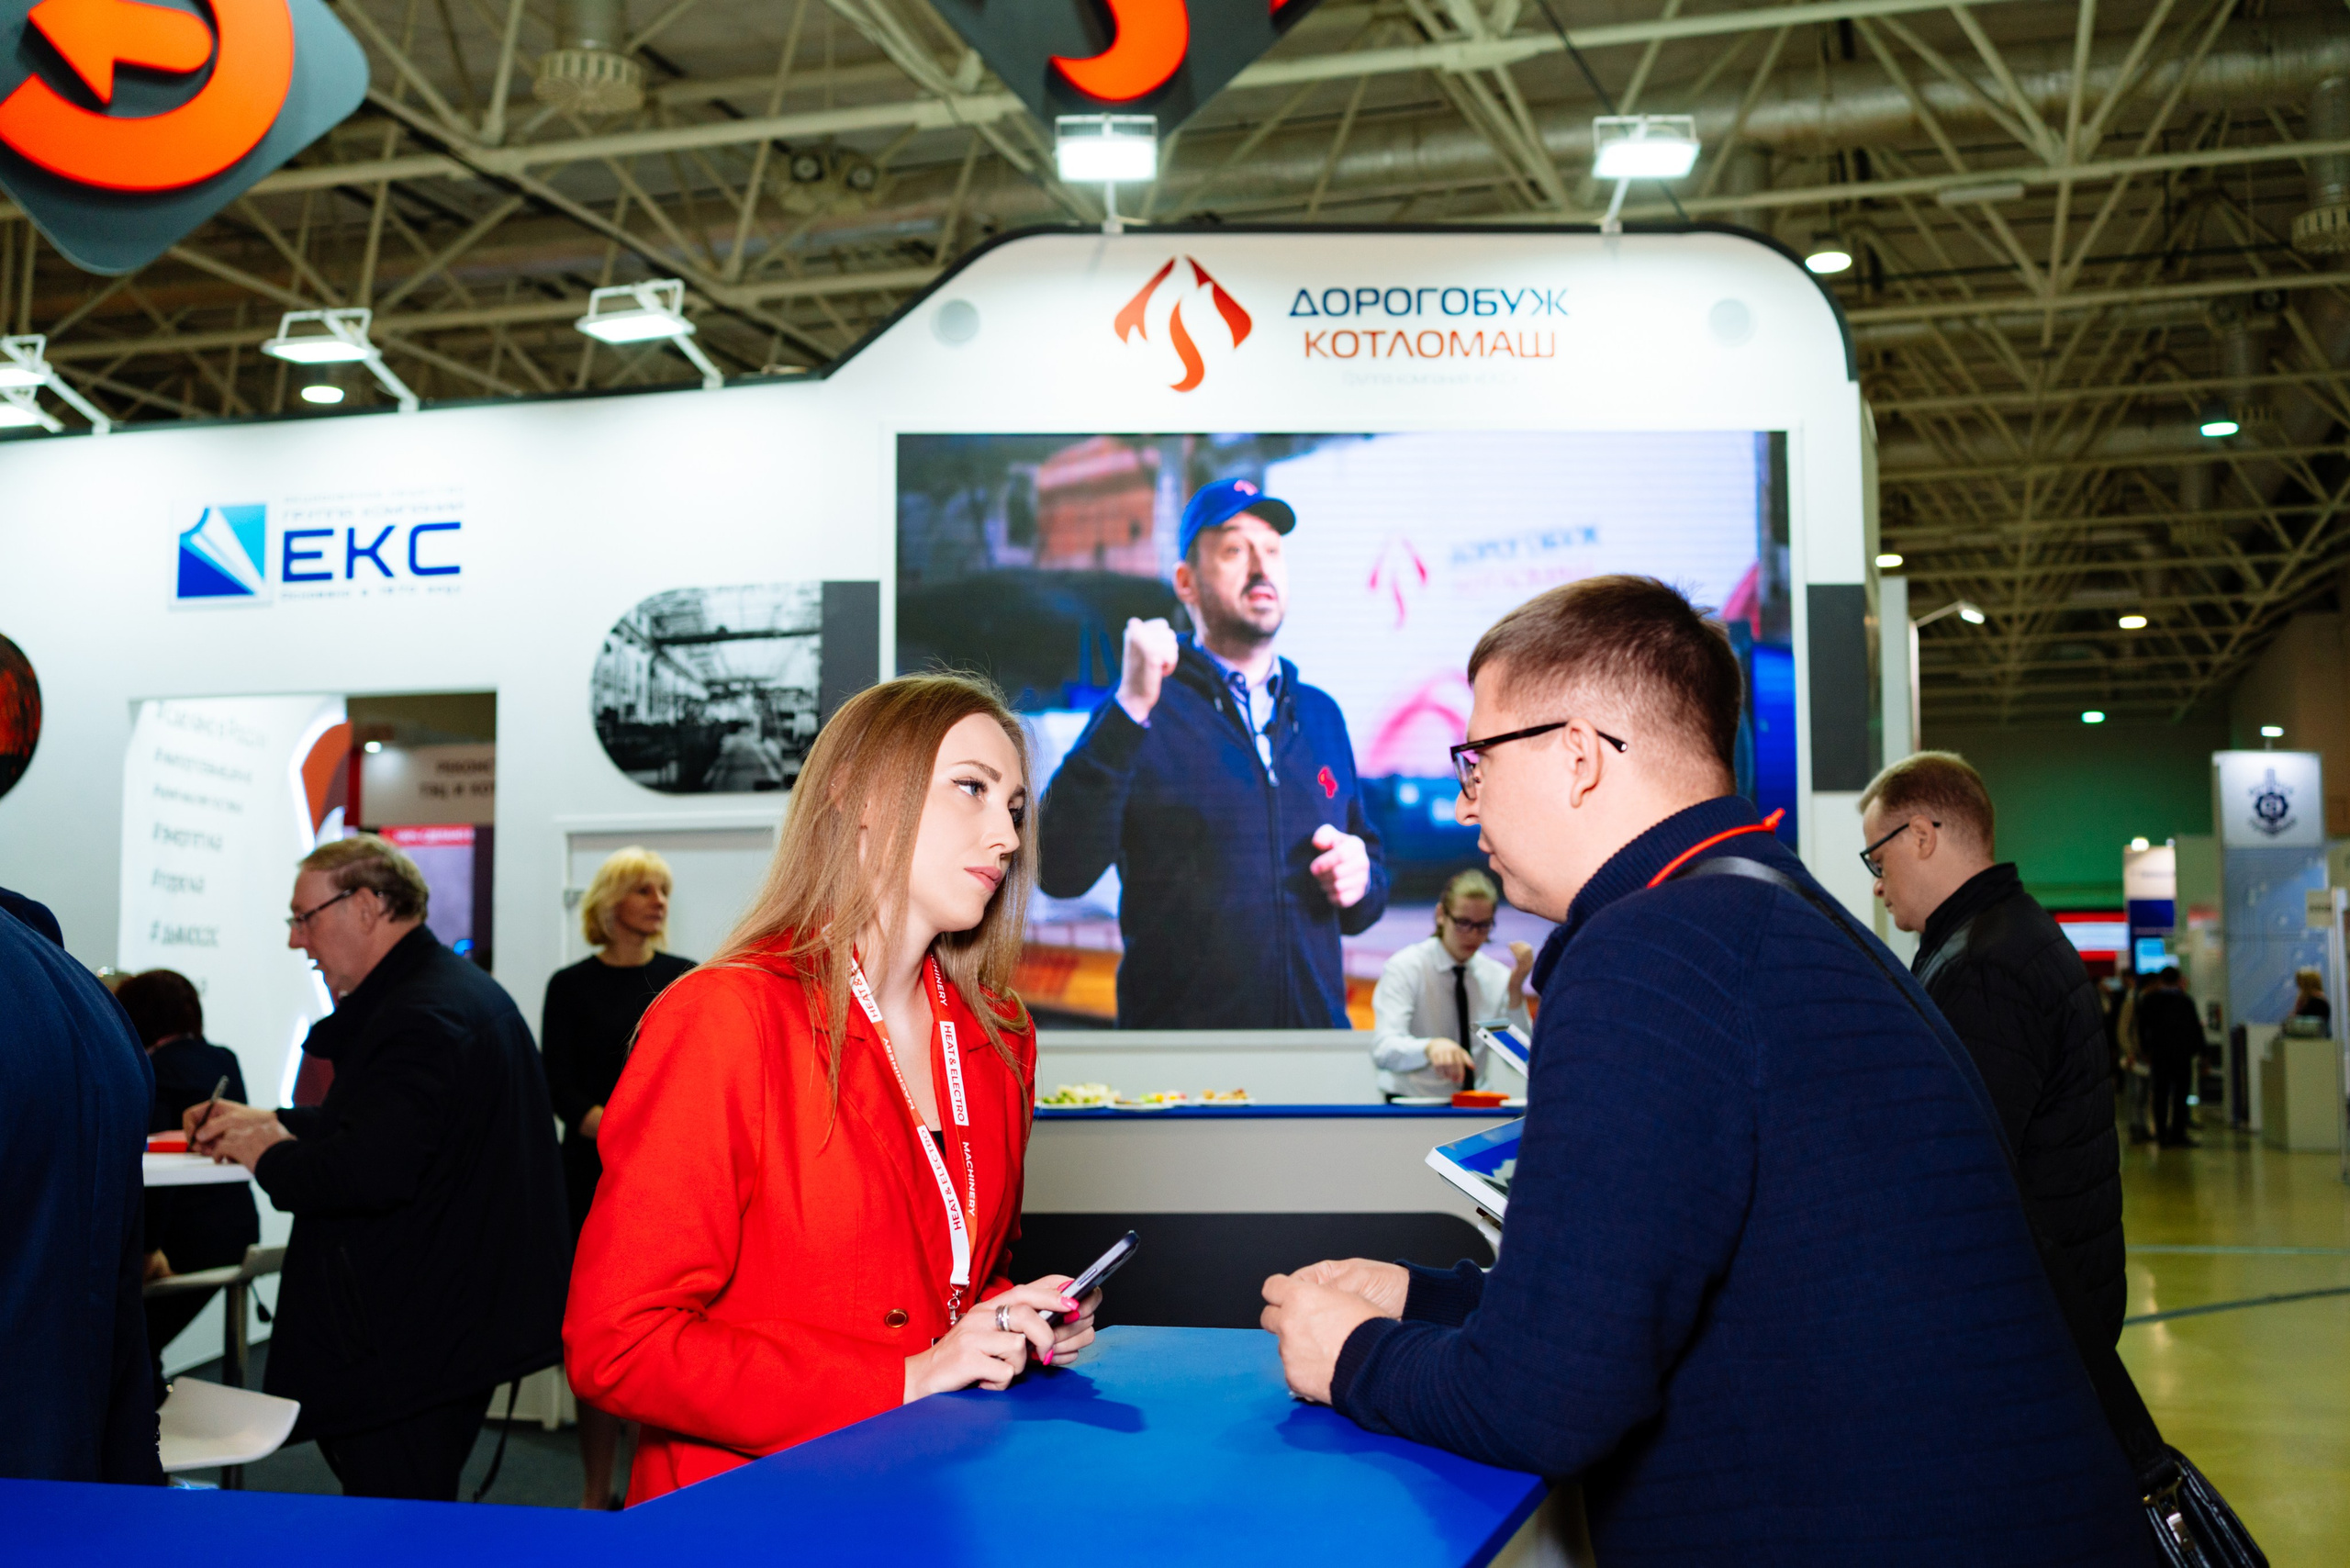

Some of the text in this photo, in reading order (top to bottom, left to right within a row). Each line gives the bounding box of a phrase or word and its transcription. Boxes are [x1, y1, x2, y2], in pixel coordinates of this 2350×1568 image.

[1289, 287, 1569, 317] ДОРОГОБУЖ
[1304, 330, 1556, 359] КОТЛОМАШ
[282, 521, 462, 583] ЕКС
[858, 989, 878, 1018] HEAT
[882, 1037, 915, 1110] MACHINERY
[944, 1025, 956, 1056] HEAT
[950, 1069, 965, 1122] ELECTRO
[921, 1129, 961, 1230] HEAT & ELECTRO
[962, 1141, 976, 1217] MACHINERY
